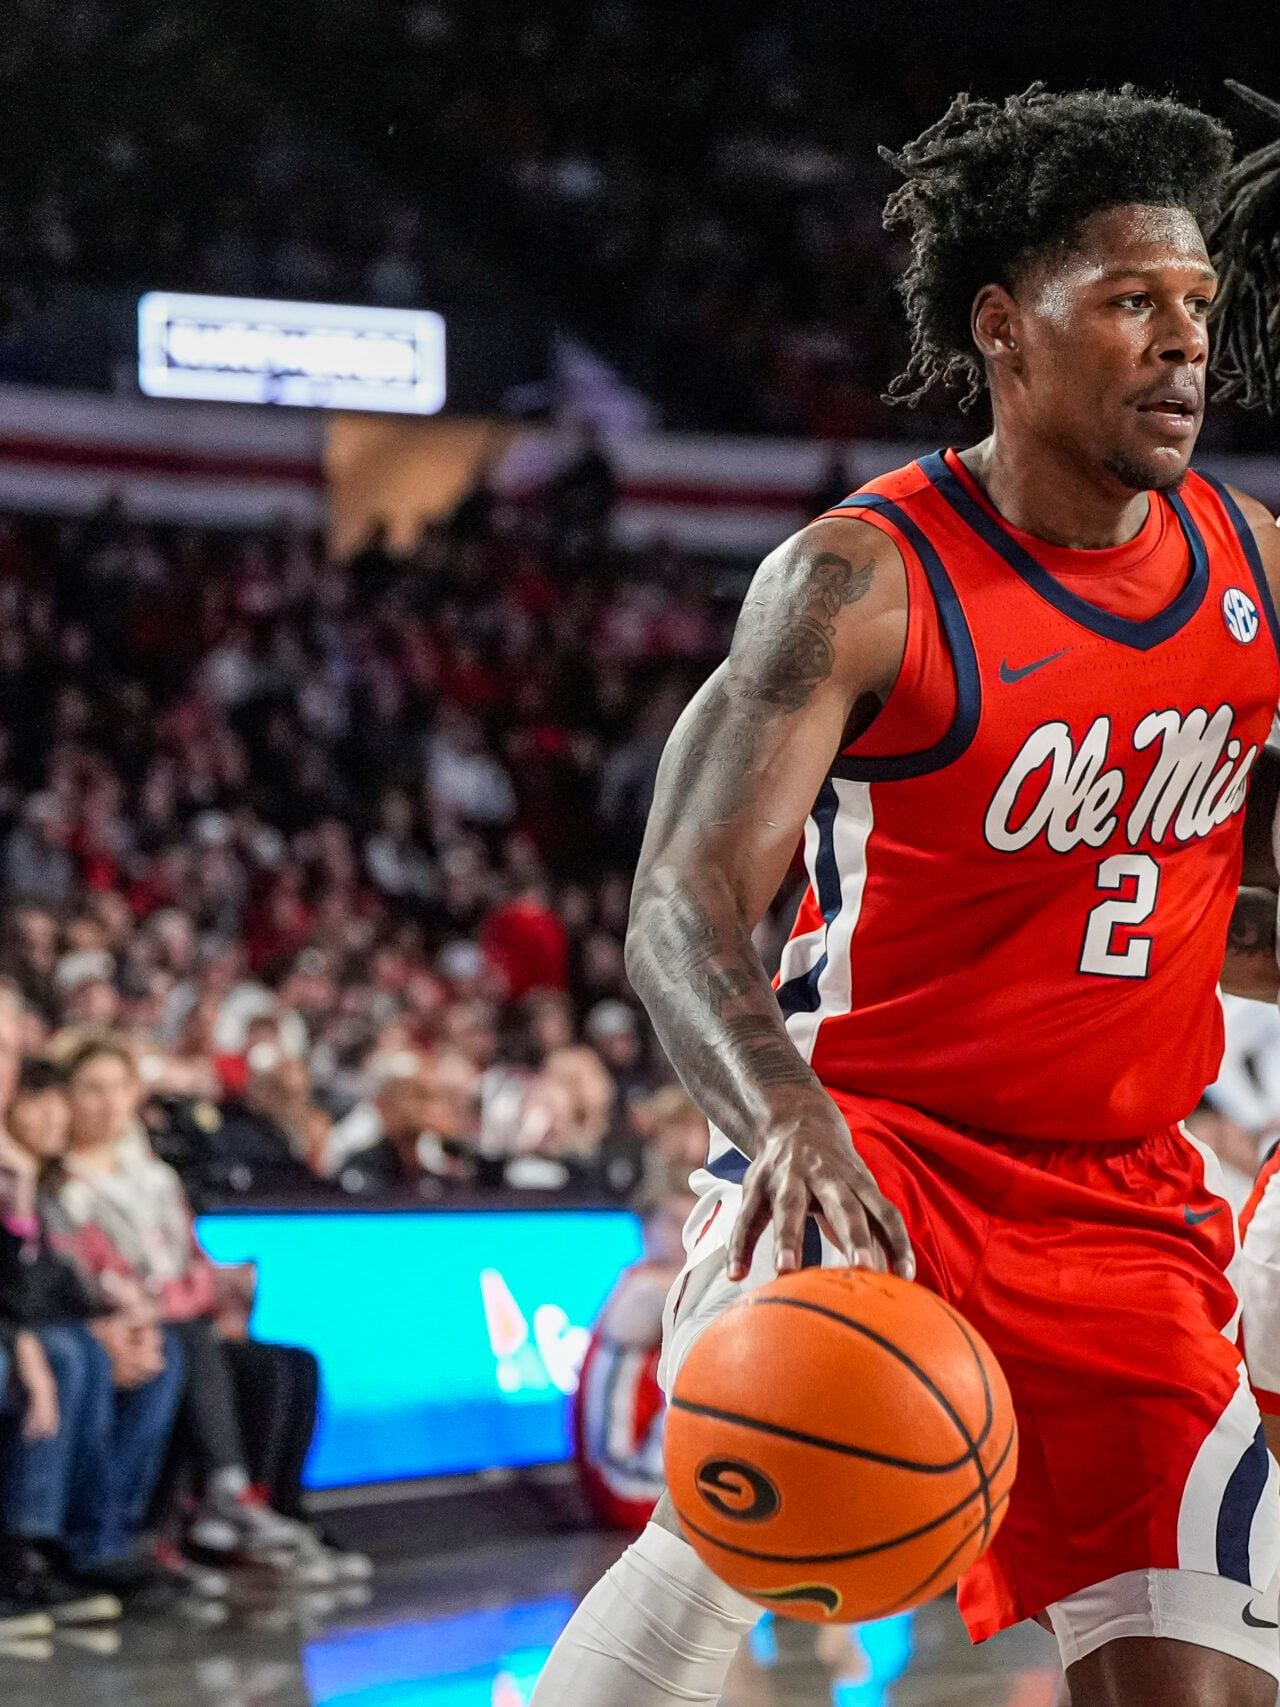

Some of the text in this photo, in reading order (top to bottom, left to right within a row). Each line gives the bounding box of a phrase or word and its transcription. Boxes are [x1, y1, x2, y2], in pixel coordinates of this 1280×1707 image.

[1223, 588, 1260, 643] SEC
[984, 716, 1125, 852] Ole
[1126, 702, 1258, 846] Mis
[1077, 853, 1160, 979] 2
